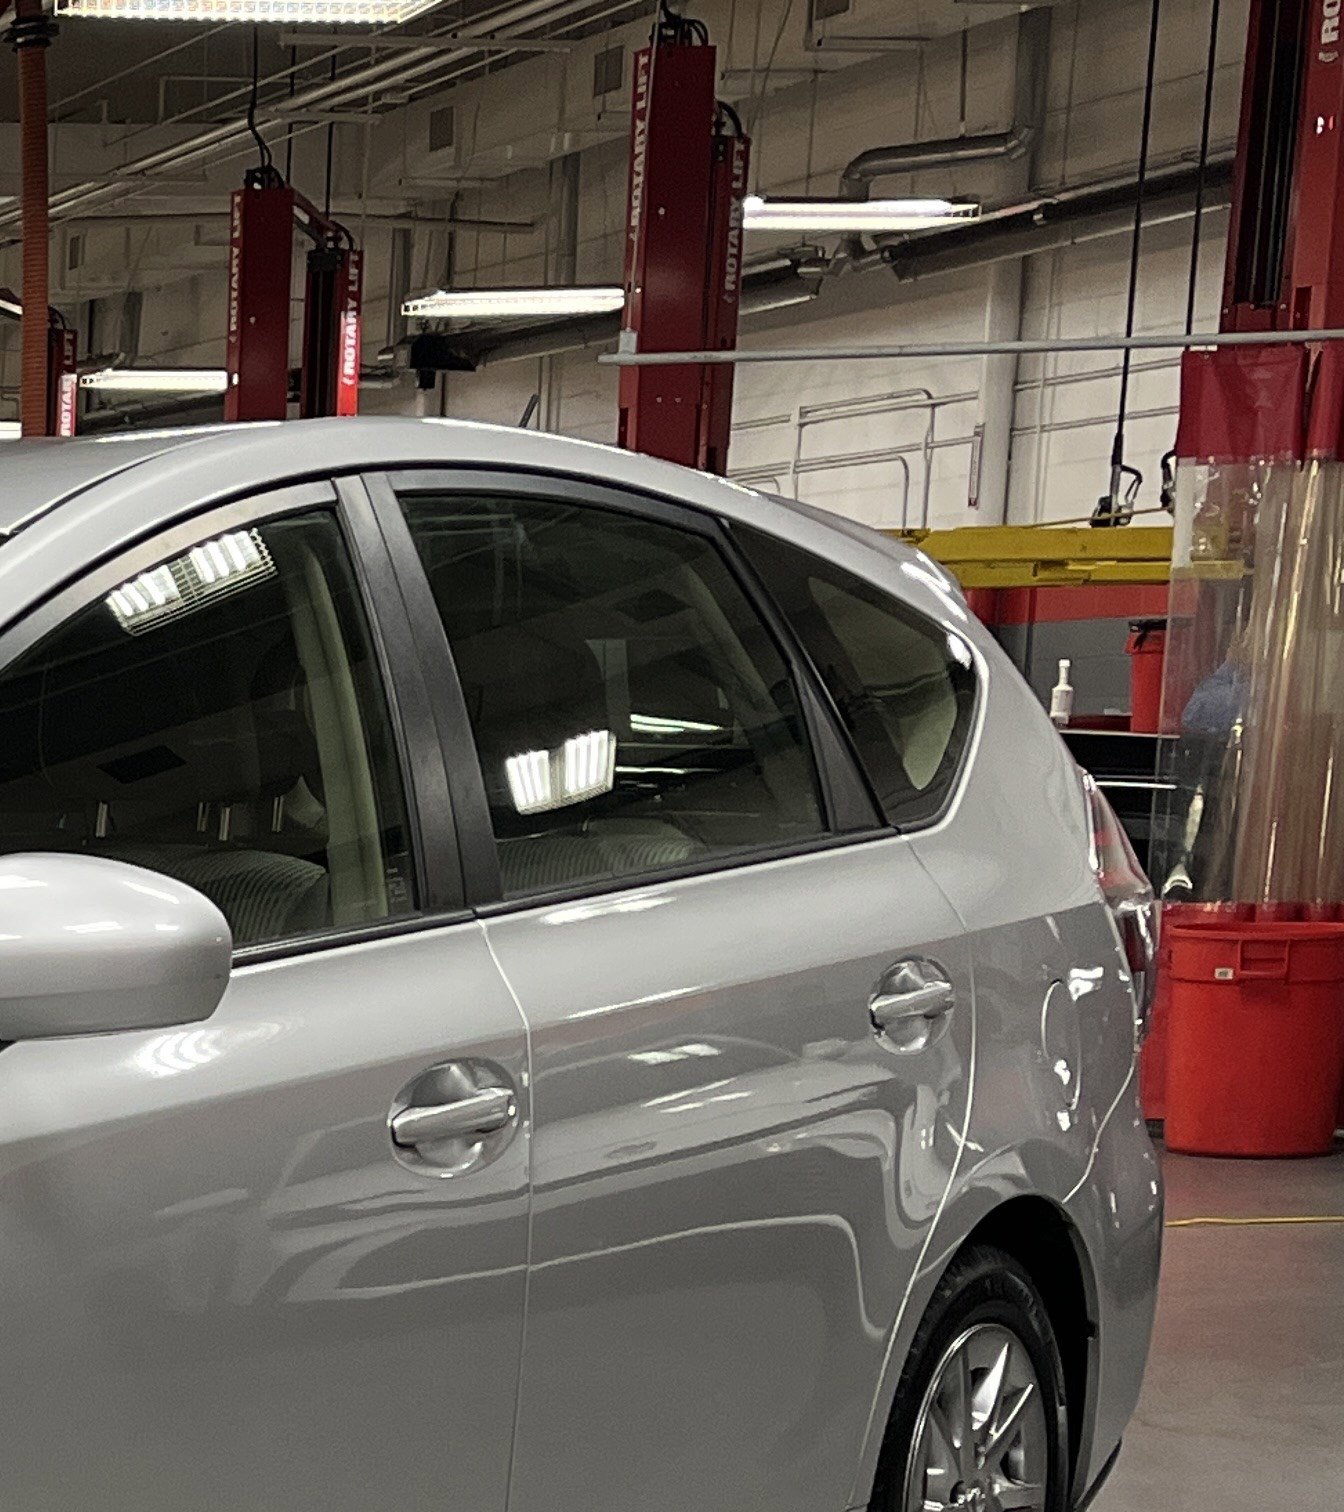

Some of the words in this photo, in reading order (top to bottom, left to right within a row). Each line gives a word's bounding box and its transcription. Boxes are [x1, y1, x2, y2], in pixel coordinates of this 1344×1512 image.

[636, 54, 650, 110] LIFT
[630, 118, 648, 226] ROTARY
[732, 141, 745, 189] LIFT
[348, 250, 360, 291] LIFT
[724, 197, 742, 291] ROTARY
[229, 246, 240, 332] ROTARY
[343, 297, 357, 376] ROTARY
